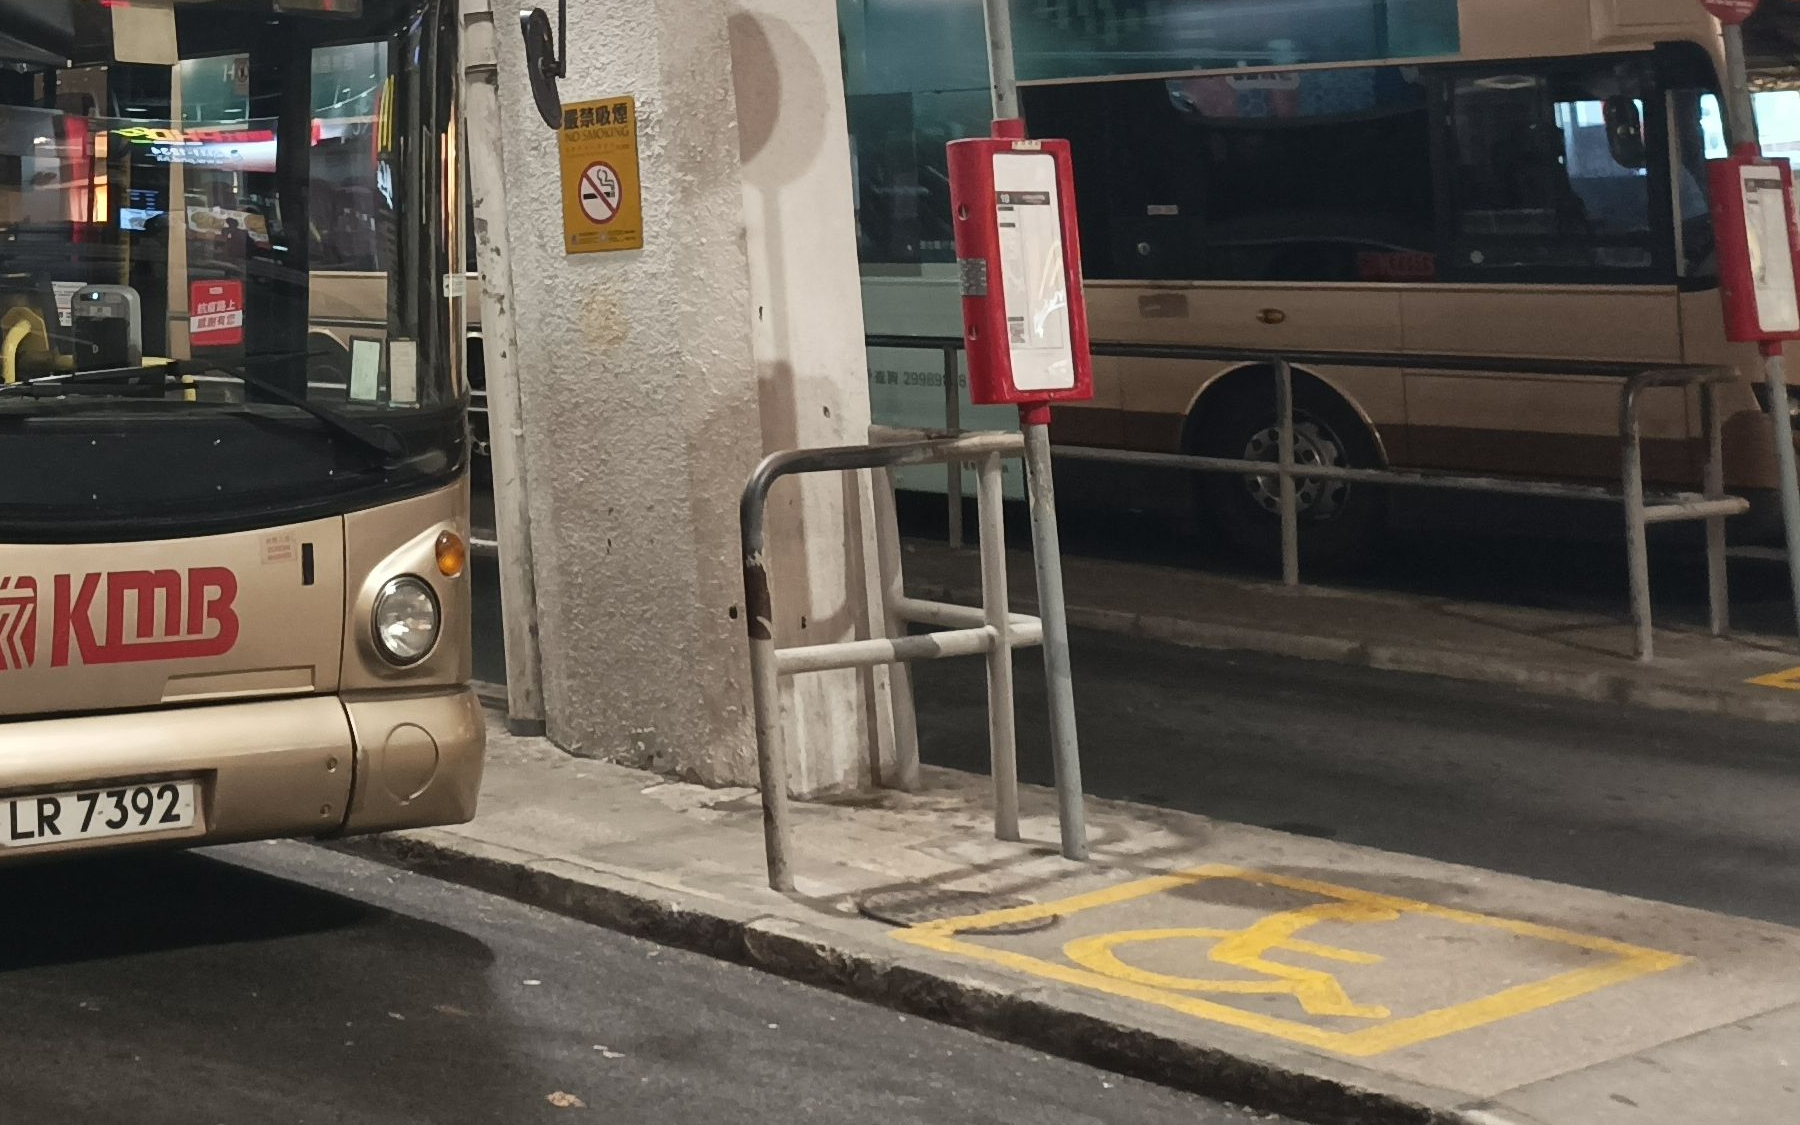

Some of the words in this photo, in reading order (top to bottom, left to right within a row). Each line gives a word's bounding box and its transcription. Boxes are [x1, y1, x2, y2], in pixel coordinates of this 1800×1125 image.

[563, 102, 628, 132] 嚴禁吸煙
[565, 131, 580, 143] NO
[582, 125, 630, 142] SMOKING
[51, 566, 239, 668] KMB
[9, 797, 61, 840] LR
[76, 783, 181, 833] 7392
